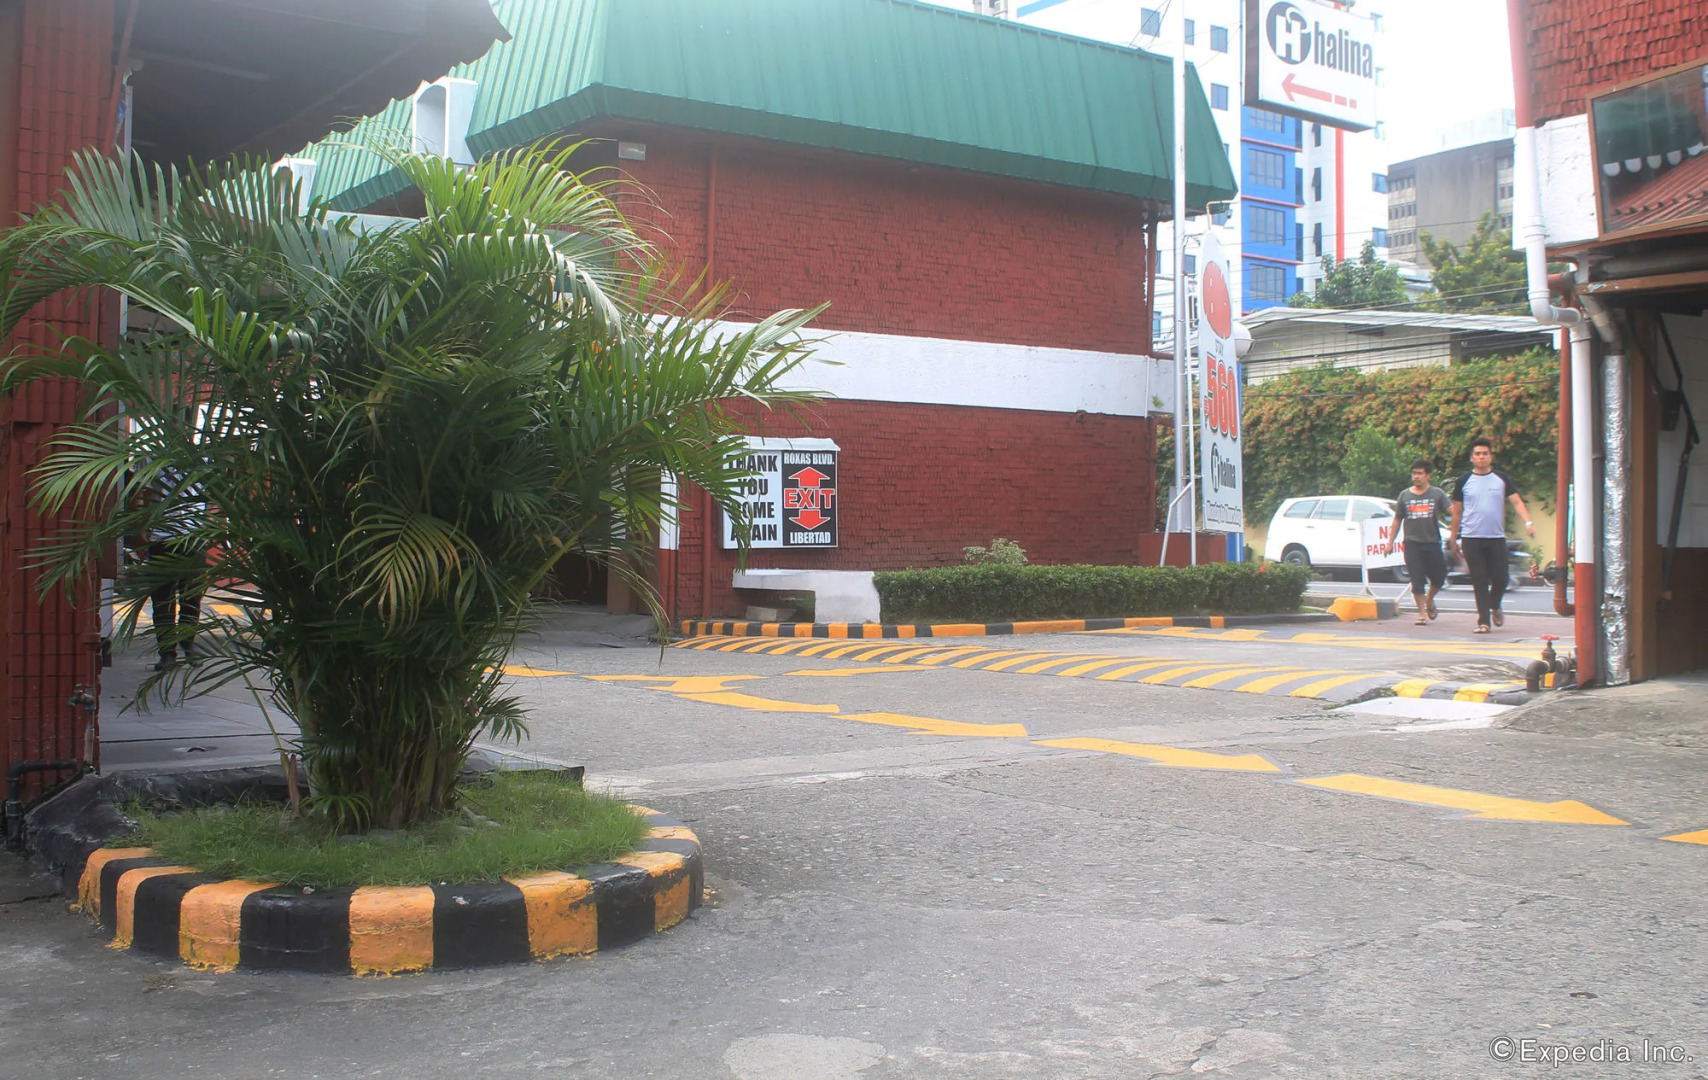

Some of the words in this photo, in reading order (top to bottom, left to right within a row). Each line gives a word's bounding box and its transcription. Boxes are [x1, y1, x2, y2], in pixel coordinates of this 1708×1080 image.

[1314, 21, 1374, 79] halina
[1206, 351, 1238, 442] 560
[784, 453, 812, 465] ROXAS
[812, 453, 835, 465] BLVD.
[784, 488, 836, 509] EXIT
[738, 501, 775, 519] OME
[730, 524, 777, 541] AAIN
[790, 532, 831, 544] LIBERTAD
[1379, 525, 1393, 539] N
